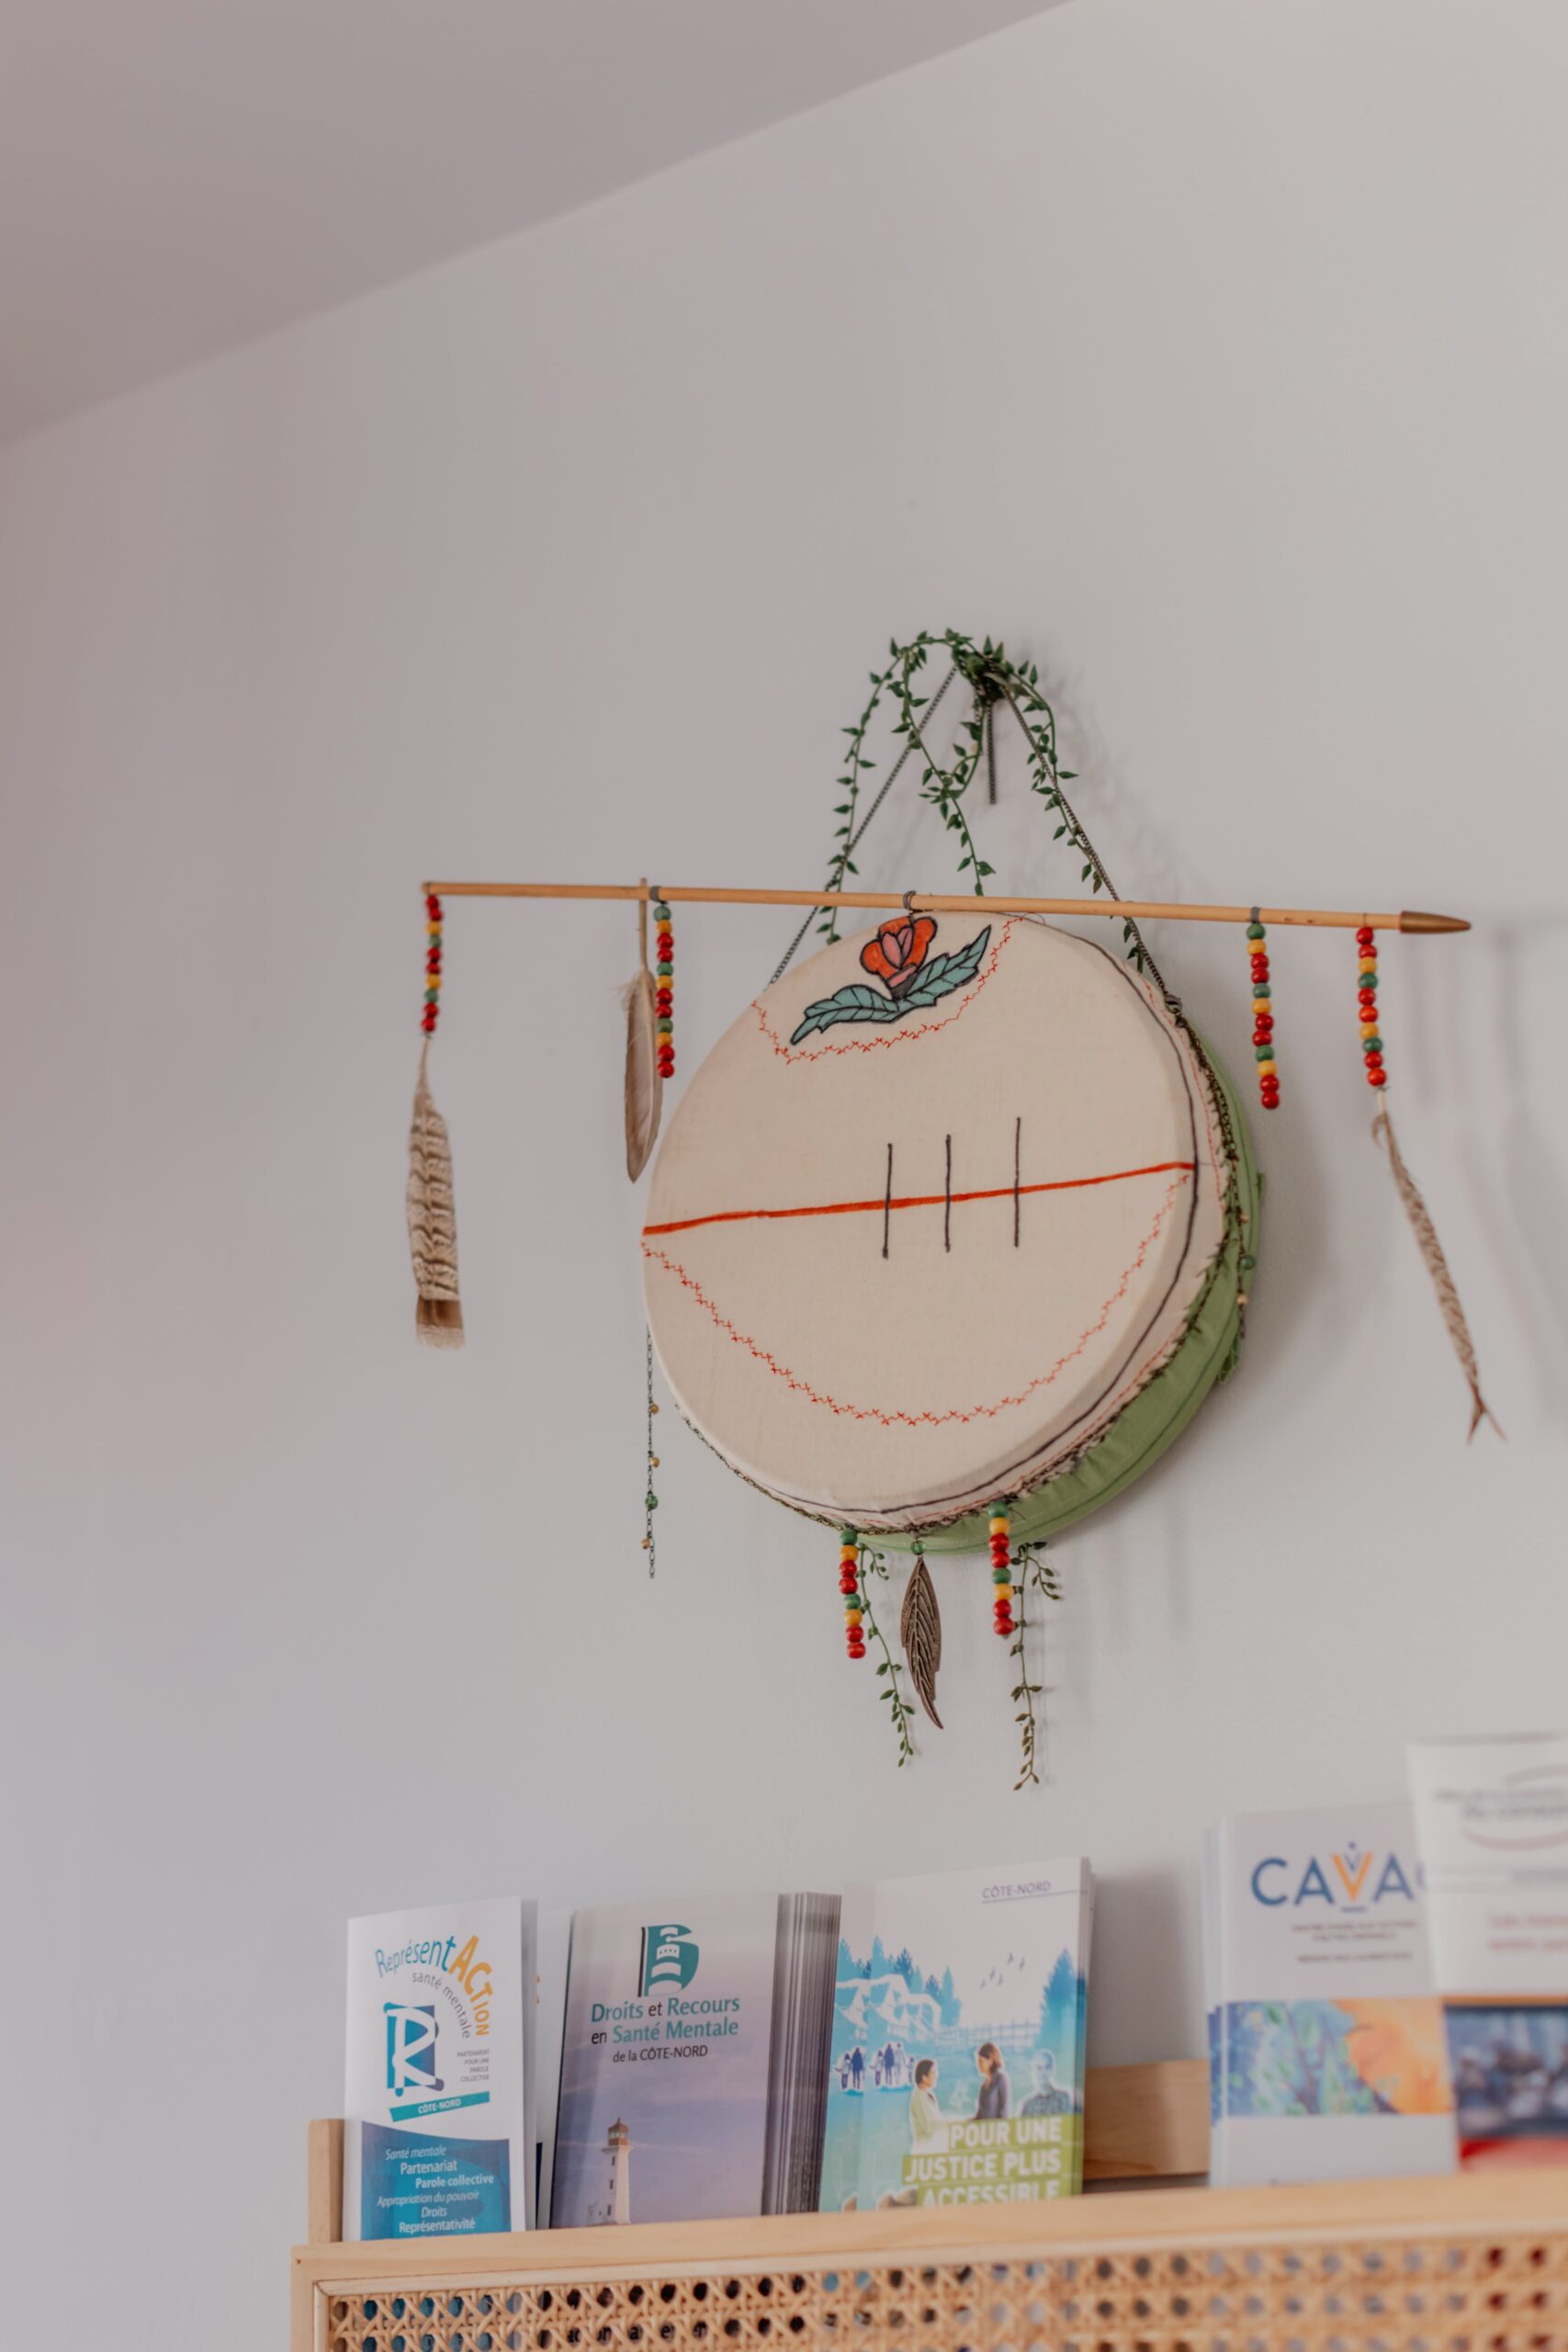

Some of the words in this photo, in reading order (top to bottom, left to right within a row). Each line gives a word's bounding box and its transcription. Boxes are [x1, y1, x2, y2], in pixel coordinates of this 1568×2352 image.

[1251, 1851, 1427, 1906] CAVA
[982, 1880, 1052, 1900] CÔTE-NORD
[412, 1971, 442, 1990] santé
[443, 1984, 470, 2039] mentale
[591, 2000, 643, 2022] Droits
[648, 2002, 662, 2017] et
[667, 1996, 740, 2017] Recours
[591, 2030, 607, 2044] en
[612, 2021, 660, 2043] Santé
[665, 2017, 739, 2041] Mentale
[613, 2050, 626, 2063] de
[628, 2049, 637, 2062] la
[639, 2044, 708, 2061] CÔTE-NORD
[418, 2098, 461, 2115] CÔTE-NORD
[950, 2120, 1010, 2148] POUR
[1016, 2117, 1063, 2143] UNE
[385, 2145, 409, 2160] Santé
[411, 2144, 446, 2158] mentale
[400, 2159, 457, 2176] Partenariat
[904, 2153, 998, 2183] JUSTICE
[1003, 2149, 1062, 2177] PLUS
[415, 2176, 446, 2188] Parole
[447, 2174, 494, 2187] collective
[377, 2193, 433, 2209] Appropriation
[434, 2191, 446, 2203] du
[446, 2190, 480, 2204] pouvoir
[421, 2206, 447, 2219] Droits
[399, 2217, 476, 2234] Représentativité
